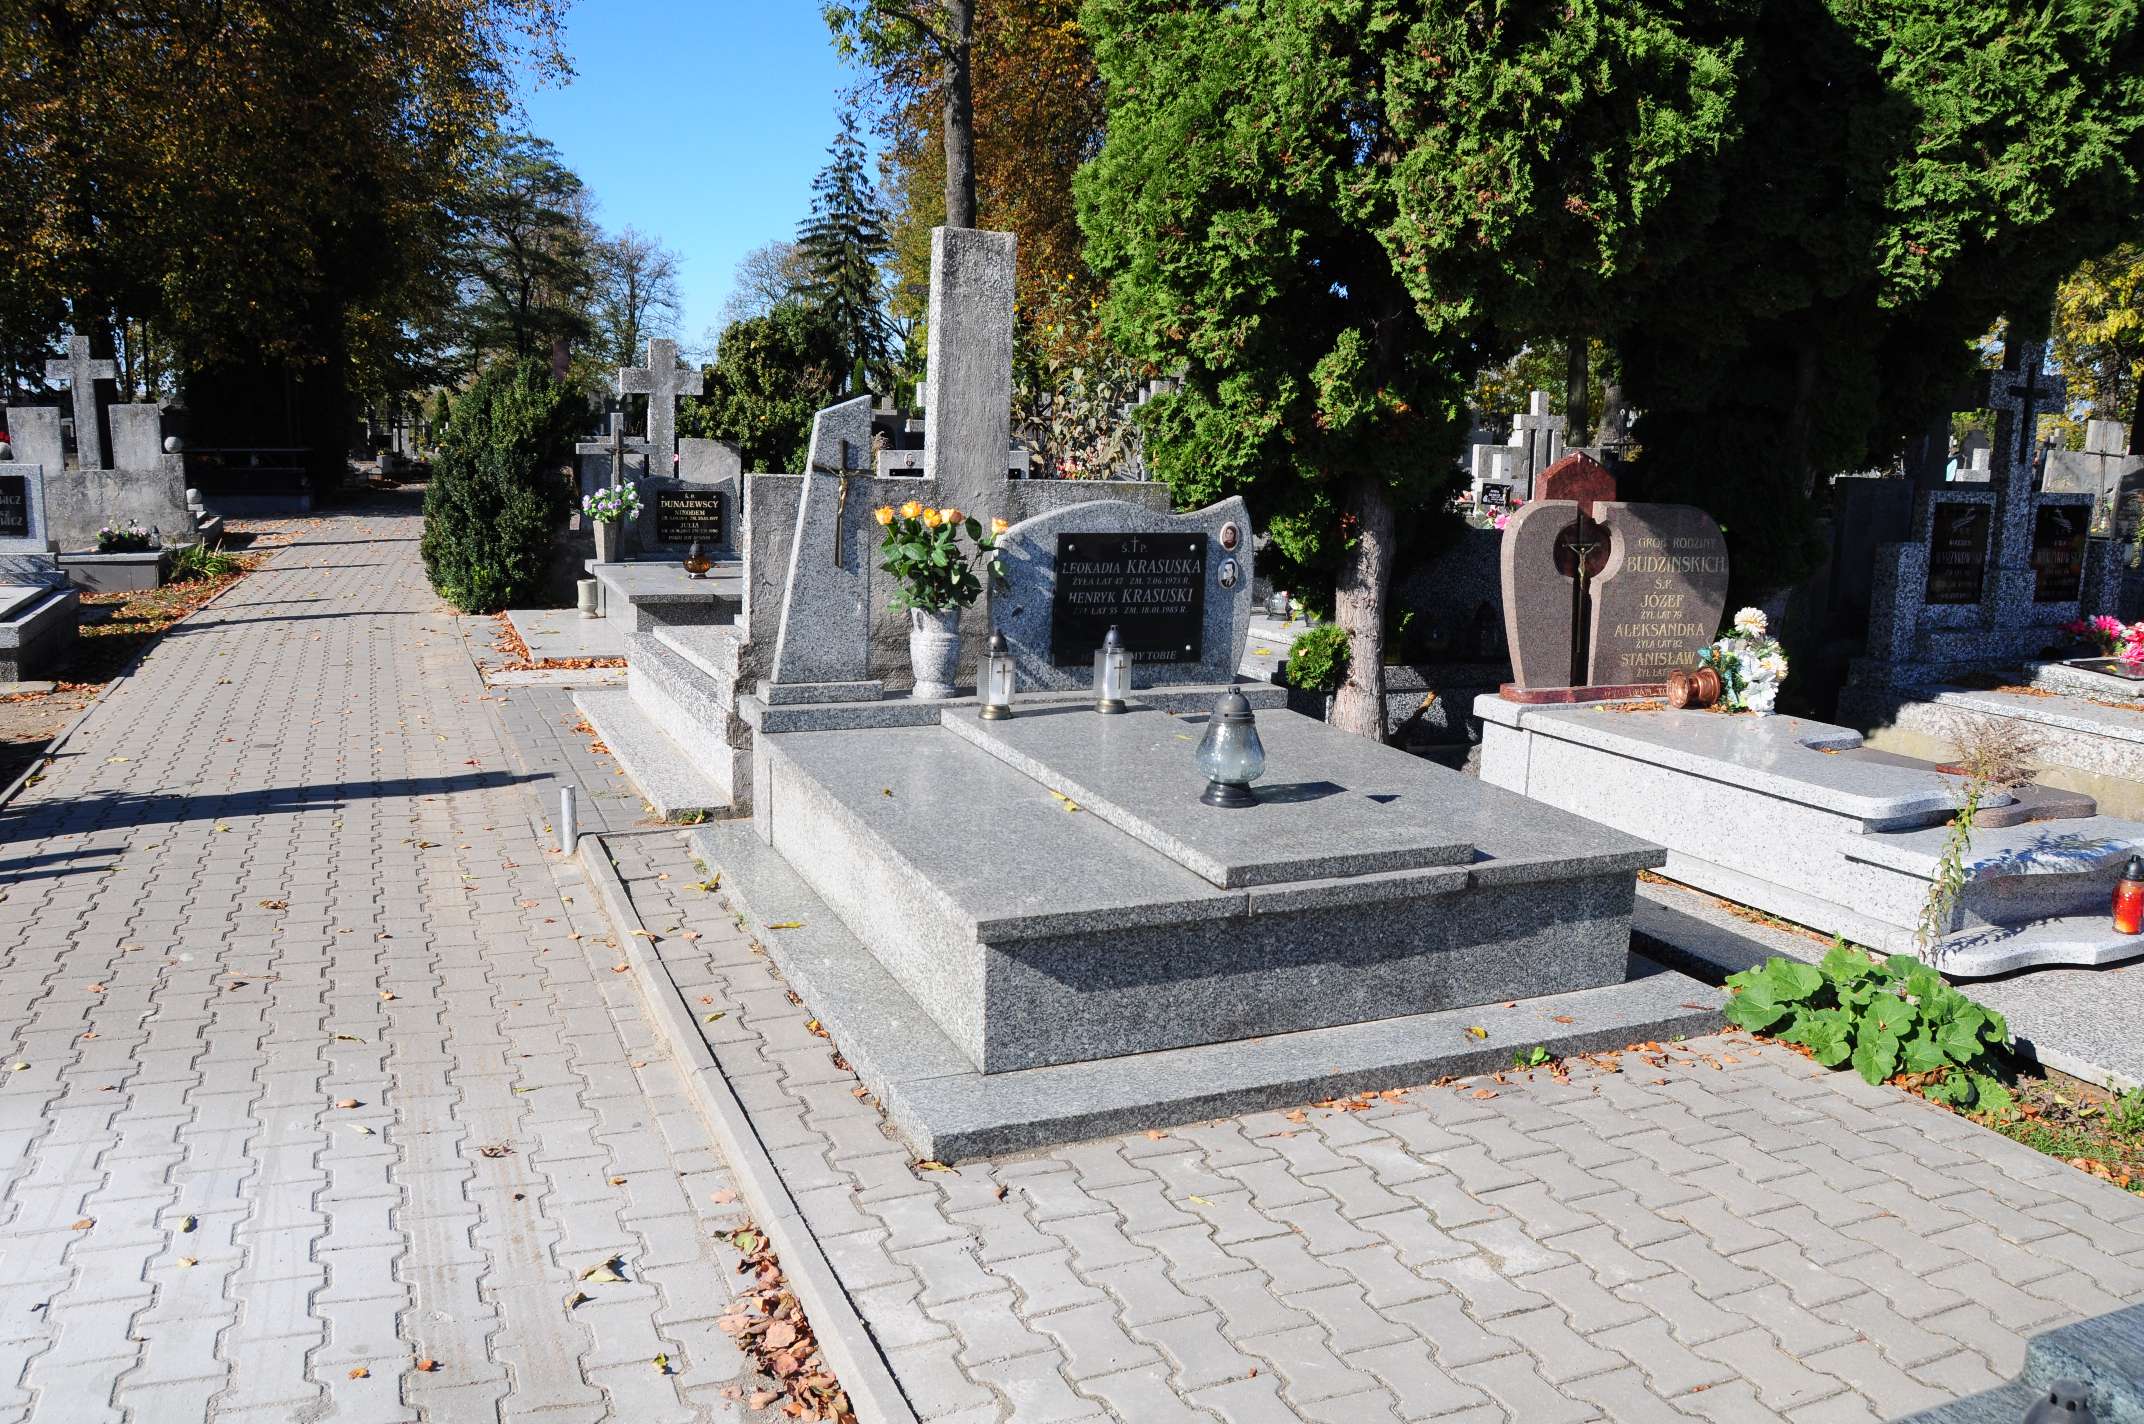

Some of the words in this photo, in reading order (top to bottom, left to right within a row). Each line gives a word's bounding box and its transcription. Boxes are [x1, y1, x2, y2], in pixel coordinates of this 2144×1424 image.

[660, 500, 719, 508] DUNAJEWSCY
[1062, 562, 1120, 574] LEOKADIA
[1126, 558, 1201, 575] KRASUSKA
[1068, 591, 1116, 604] HENRYK
[1121, 587, 1193, 603] KRASUSKI
[1640, 591, 1685, 608] JÓZEF
[1614, 623, 1705, 638] ALEKSANDRA
[1657, 639, 1671, 648] LAT
[1147, 649, 1177, 661] TOBIE
[1621, 651, 1695, 667] STANISŁAW
